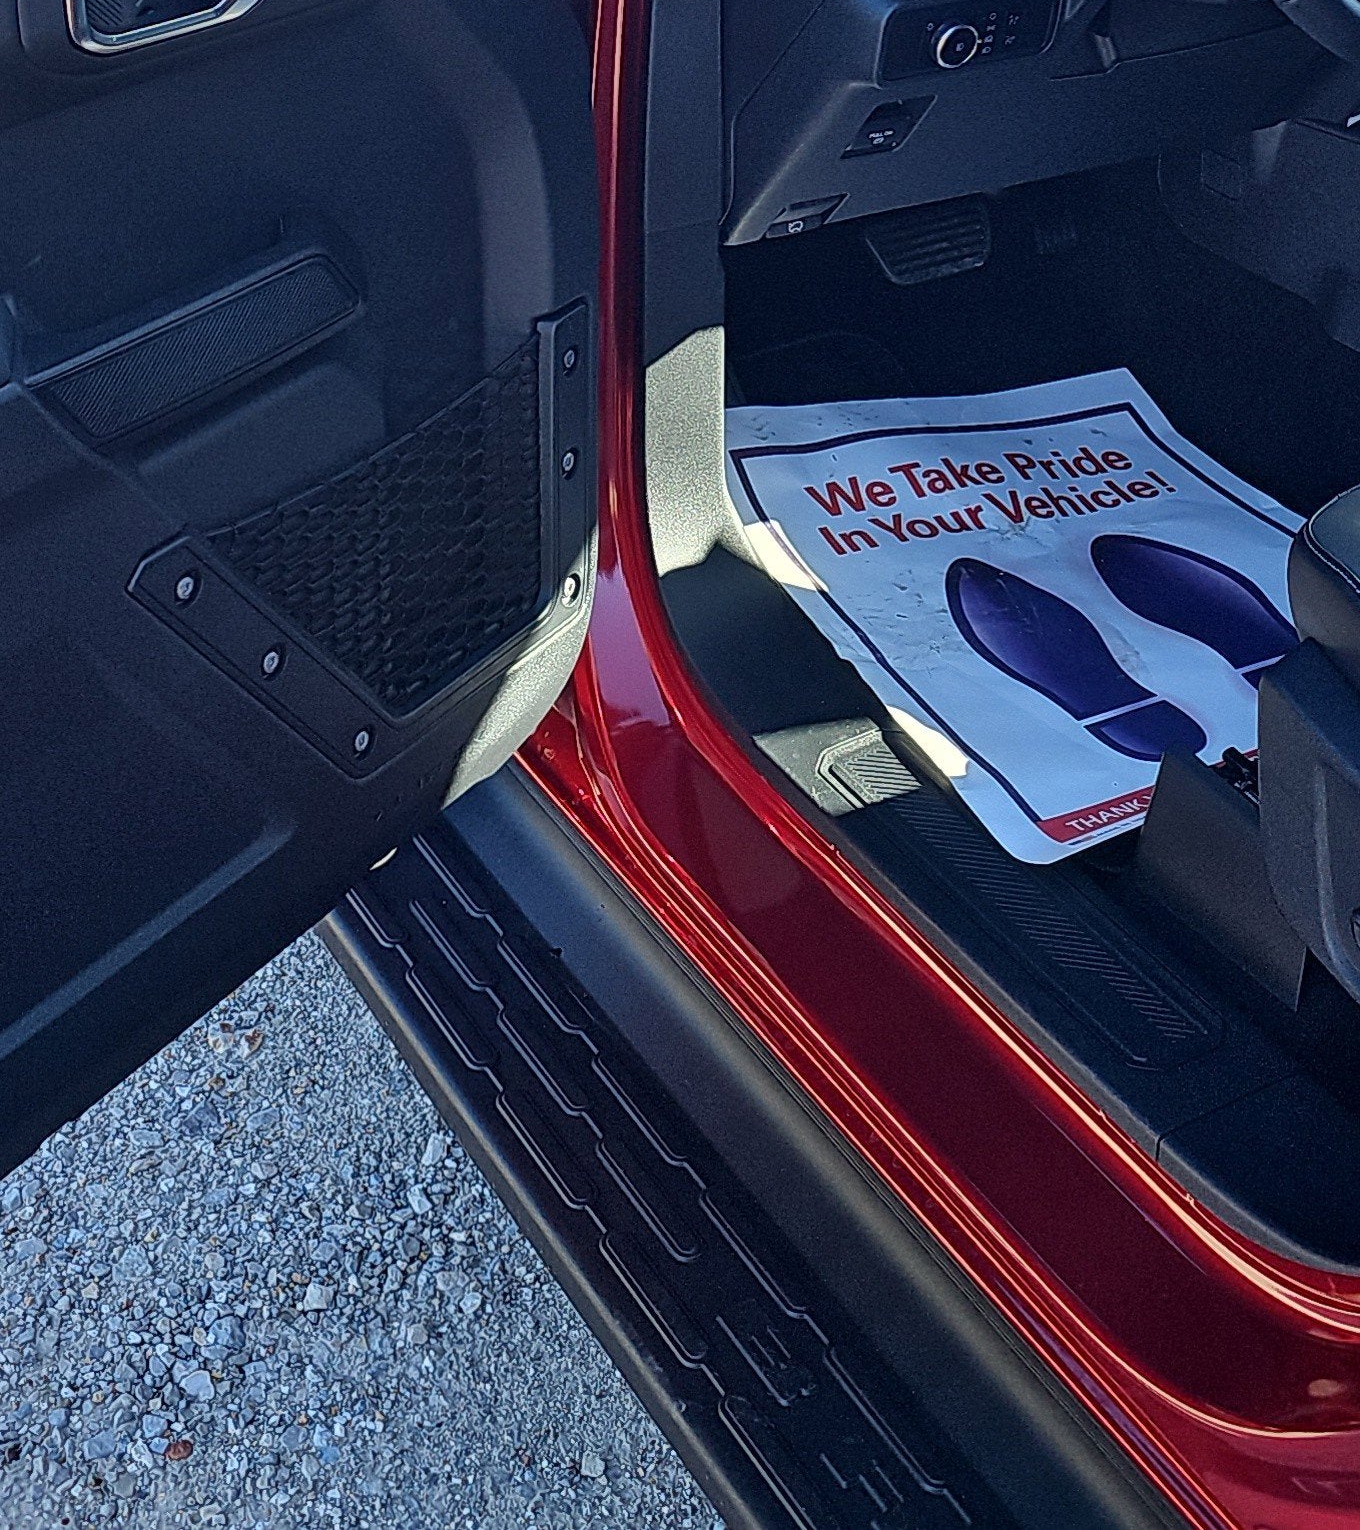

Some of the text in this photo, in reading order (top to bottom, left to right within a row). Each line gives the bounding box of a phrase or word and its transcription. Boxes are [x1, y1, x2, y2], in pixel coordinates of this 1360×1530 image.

[805, 446, 1133, 517] We Take Pride
[818, 470, 1177, 556] In Your Vehicle!
[1065, 798, 1143, 832] THANK
